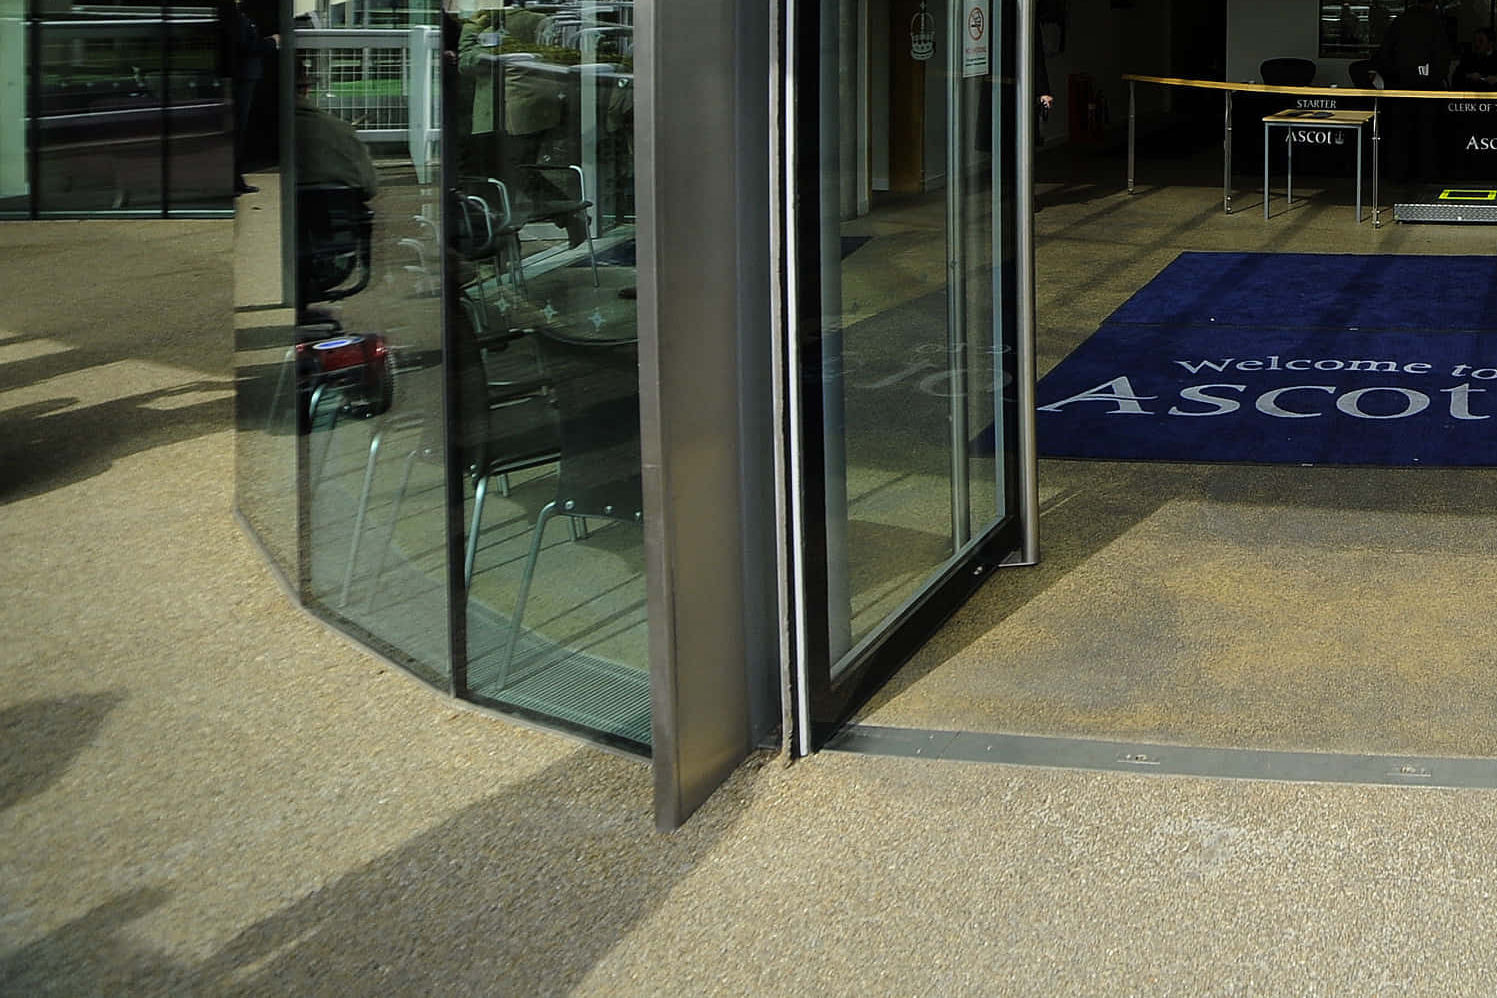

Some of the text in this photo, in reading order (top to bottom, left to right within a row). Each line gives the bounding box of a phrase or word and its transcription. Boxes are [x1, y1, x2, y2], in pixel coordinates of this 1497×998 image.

[1296, 98, 1337, 110] STARTER
[1447, 102, 1477, 113] CLERK
[1479, 102, 1492, 113] OF
